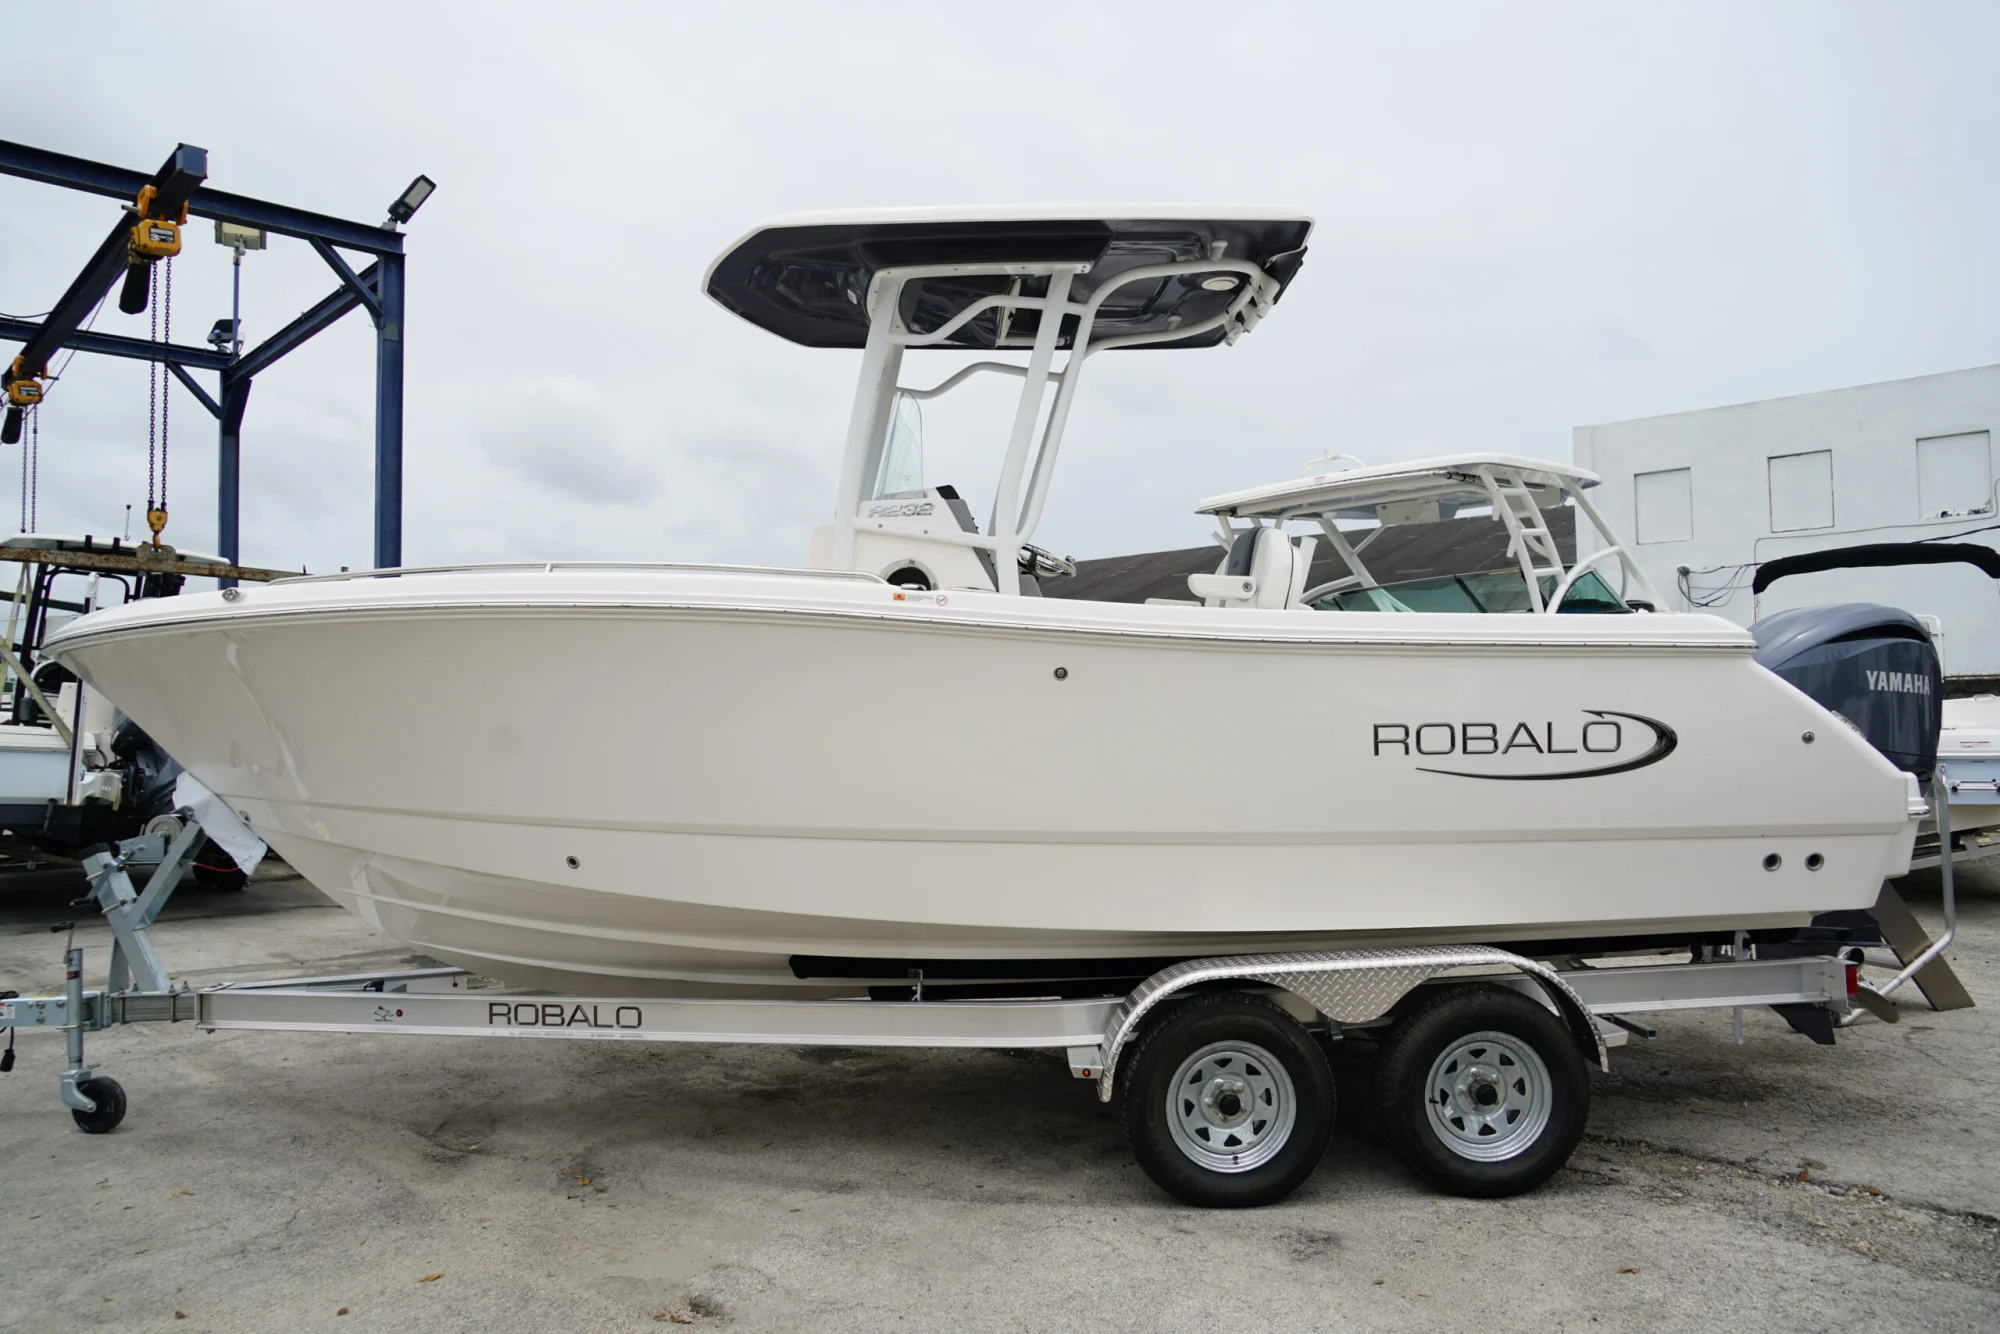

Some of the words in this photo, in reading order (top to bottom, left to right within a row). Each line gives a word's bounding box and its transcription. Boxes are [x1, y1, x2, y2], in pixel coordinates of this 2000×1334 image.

[868, 502, 935, 518] R232
[1866, 670, 1931, 695] YAMAHA
[1373, 721, 1622, 756] ROBALO
[488, 1002, 643, 1029] ROBALO
